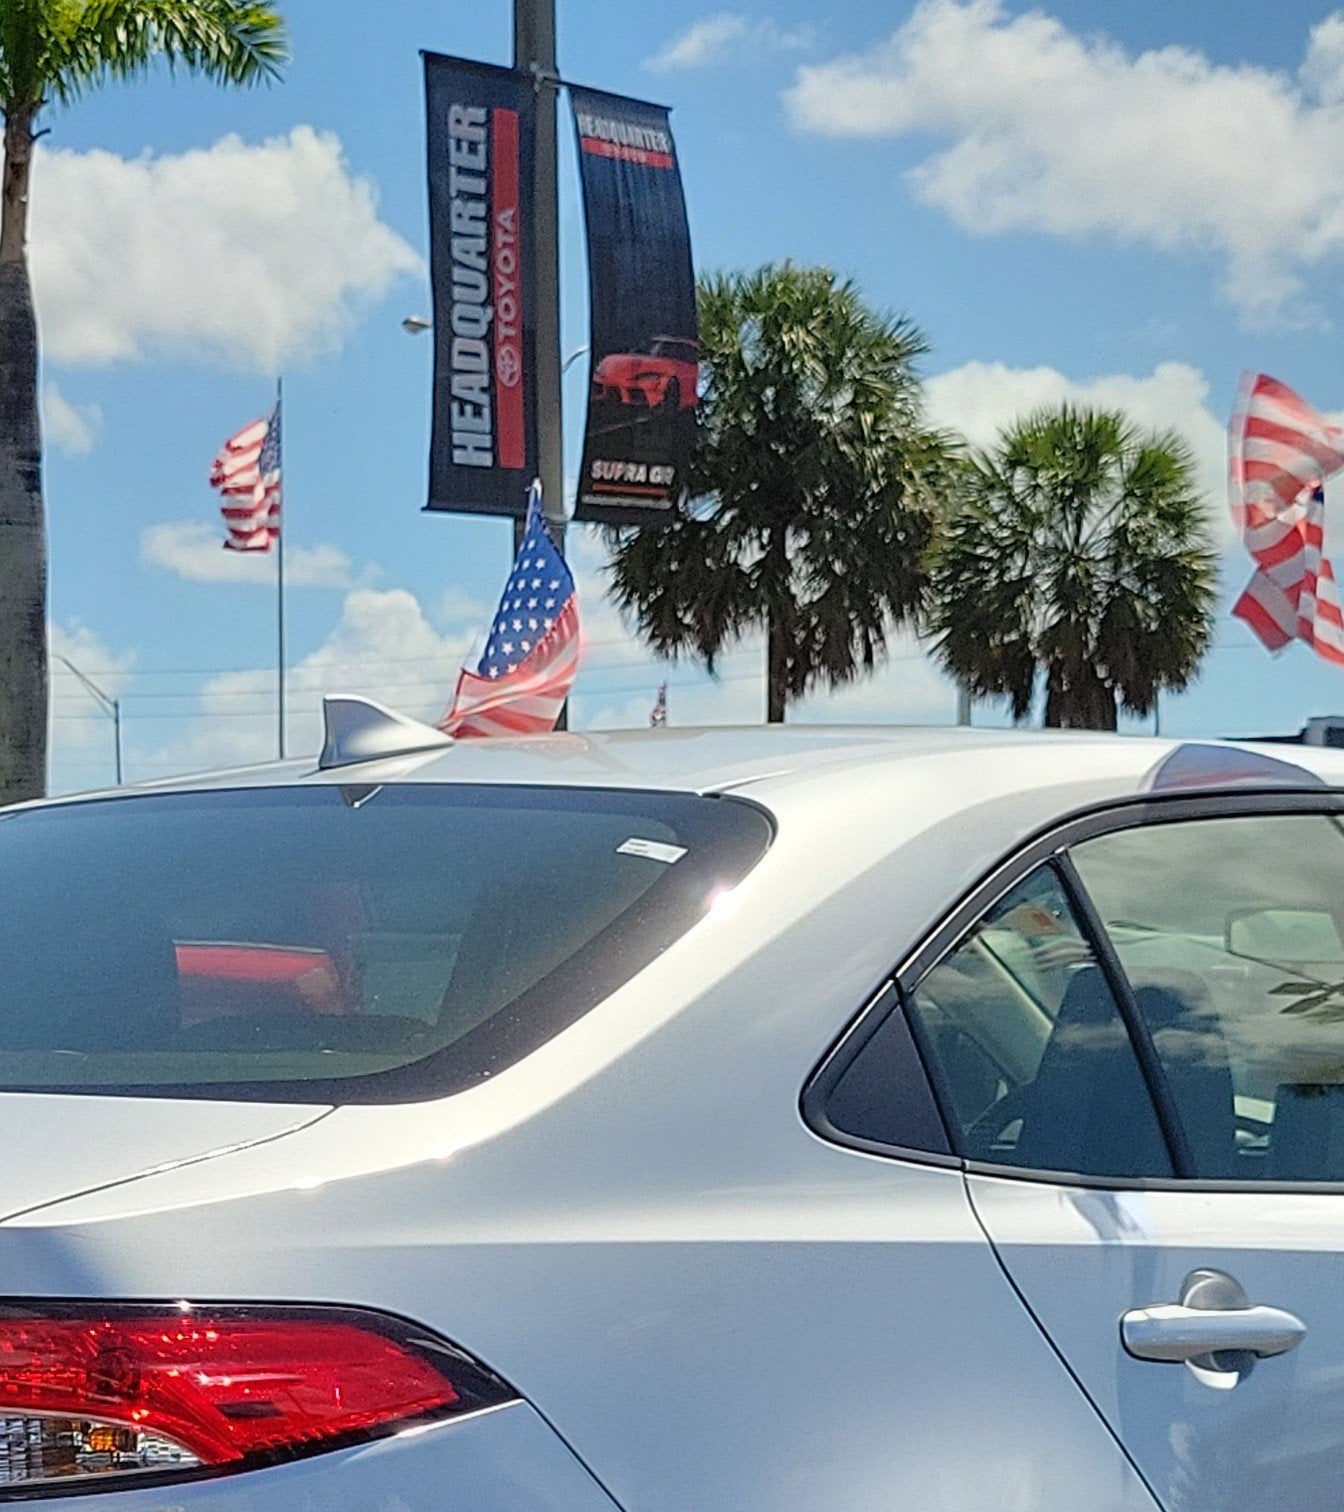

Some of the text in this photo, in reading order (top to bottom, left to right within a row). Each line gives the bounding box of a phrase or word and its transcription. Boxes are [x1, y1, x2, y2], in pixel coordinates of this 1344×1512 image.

[448, 104, 494, 468] HEADQUARTER
[496, 208, 518, 339] TOYOTA
[591, 459, 675, 486] SUPRA GR
